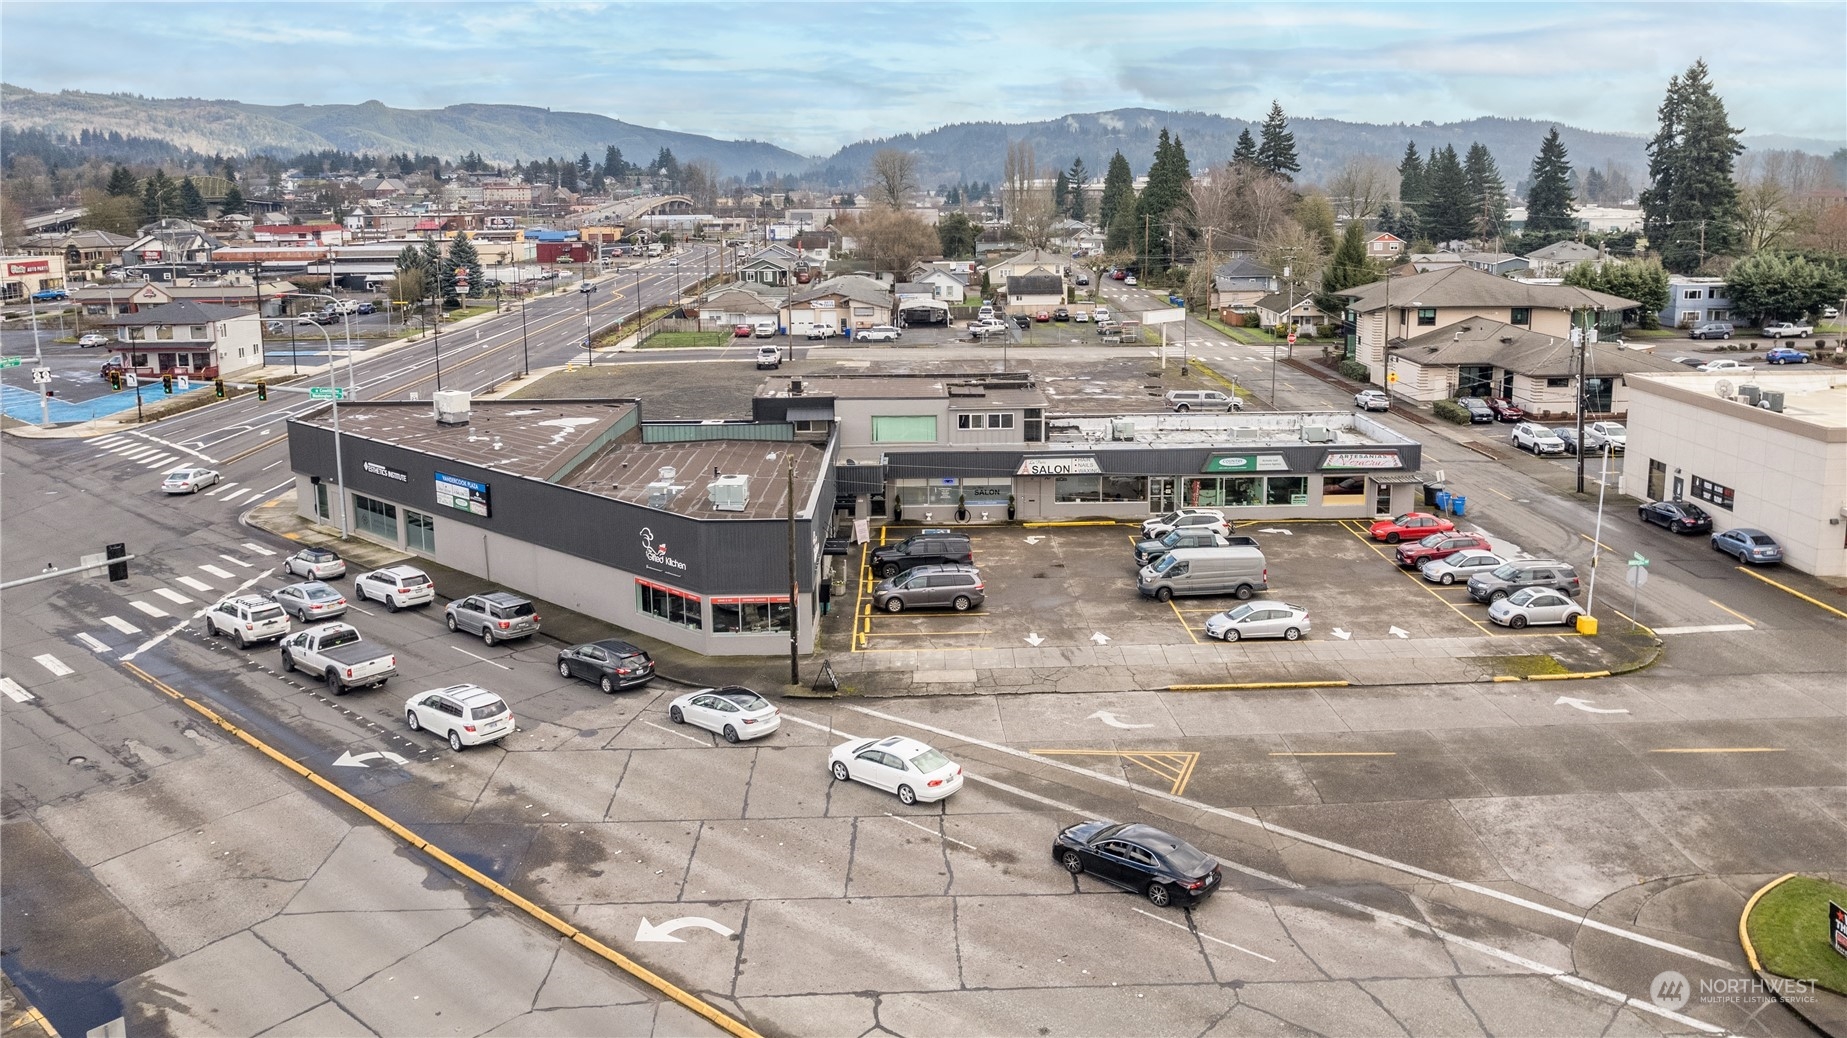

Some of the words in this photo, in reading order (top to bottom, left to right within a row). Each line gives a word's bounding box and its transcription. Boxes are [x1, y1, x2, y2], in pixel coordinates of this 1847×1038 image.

[1338, 456, 1388, 466] Veracruz
[368, 465, 388, 477] ESTHETICS
[388, 471, 407, 482] INSTITUTE
[1031, 465, 1070, 474] SALON
[467, 481, 479, 489] PLAZA
[647, 552, 664, 565] Gifted
[665, 556, 687, 571] Kitchen
[1835, 918, 1847, 937] TH
